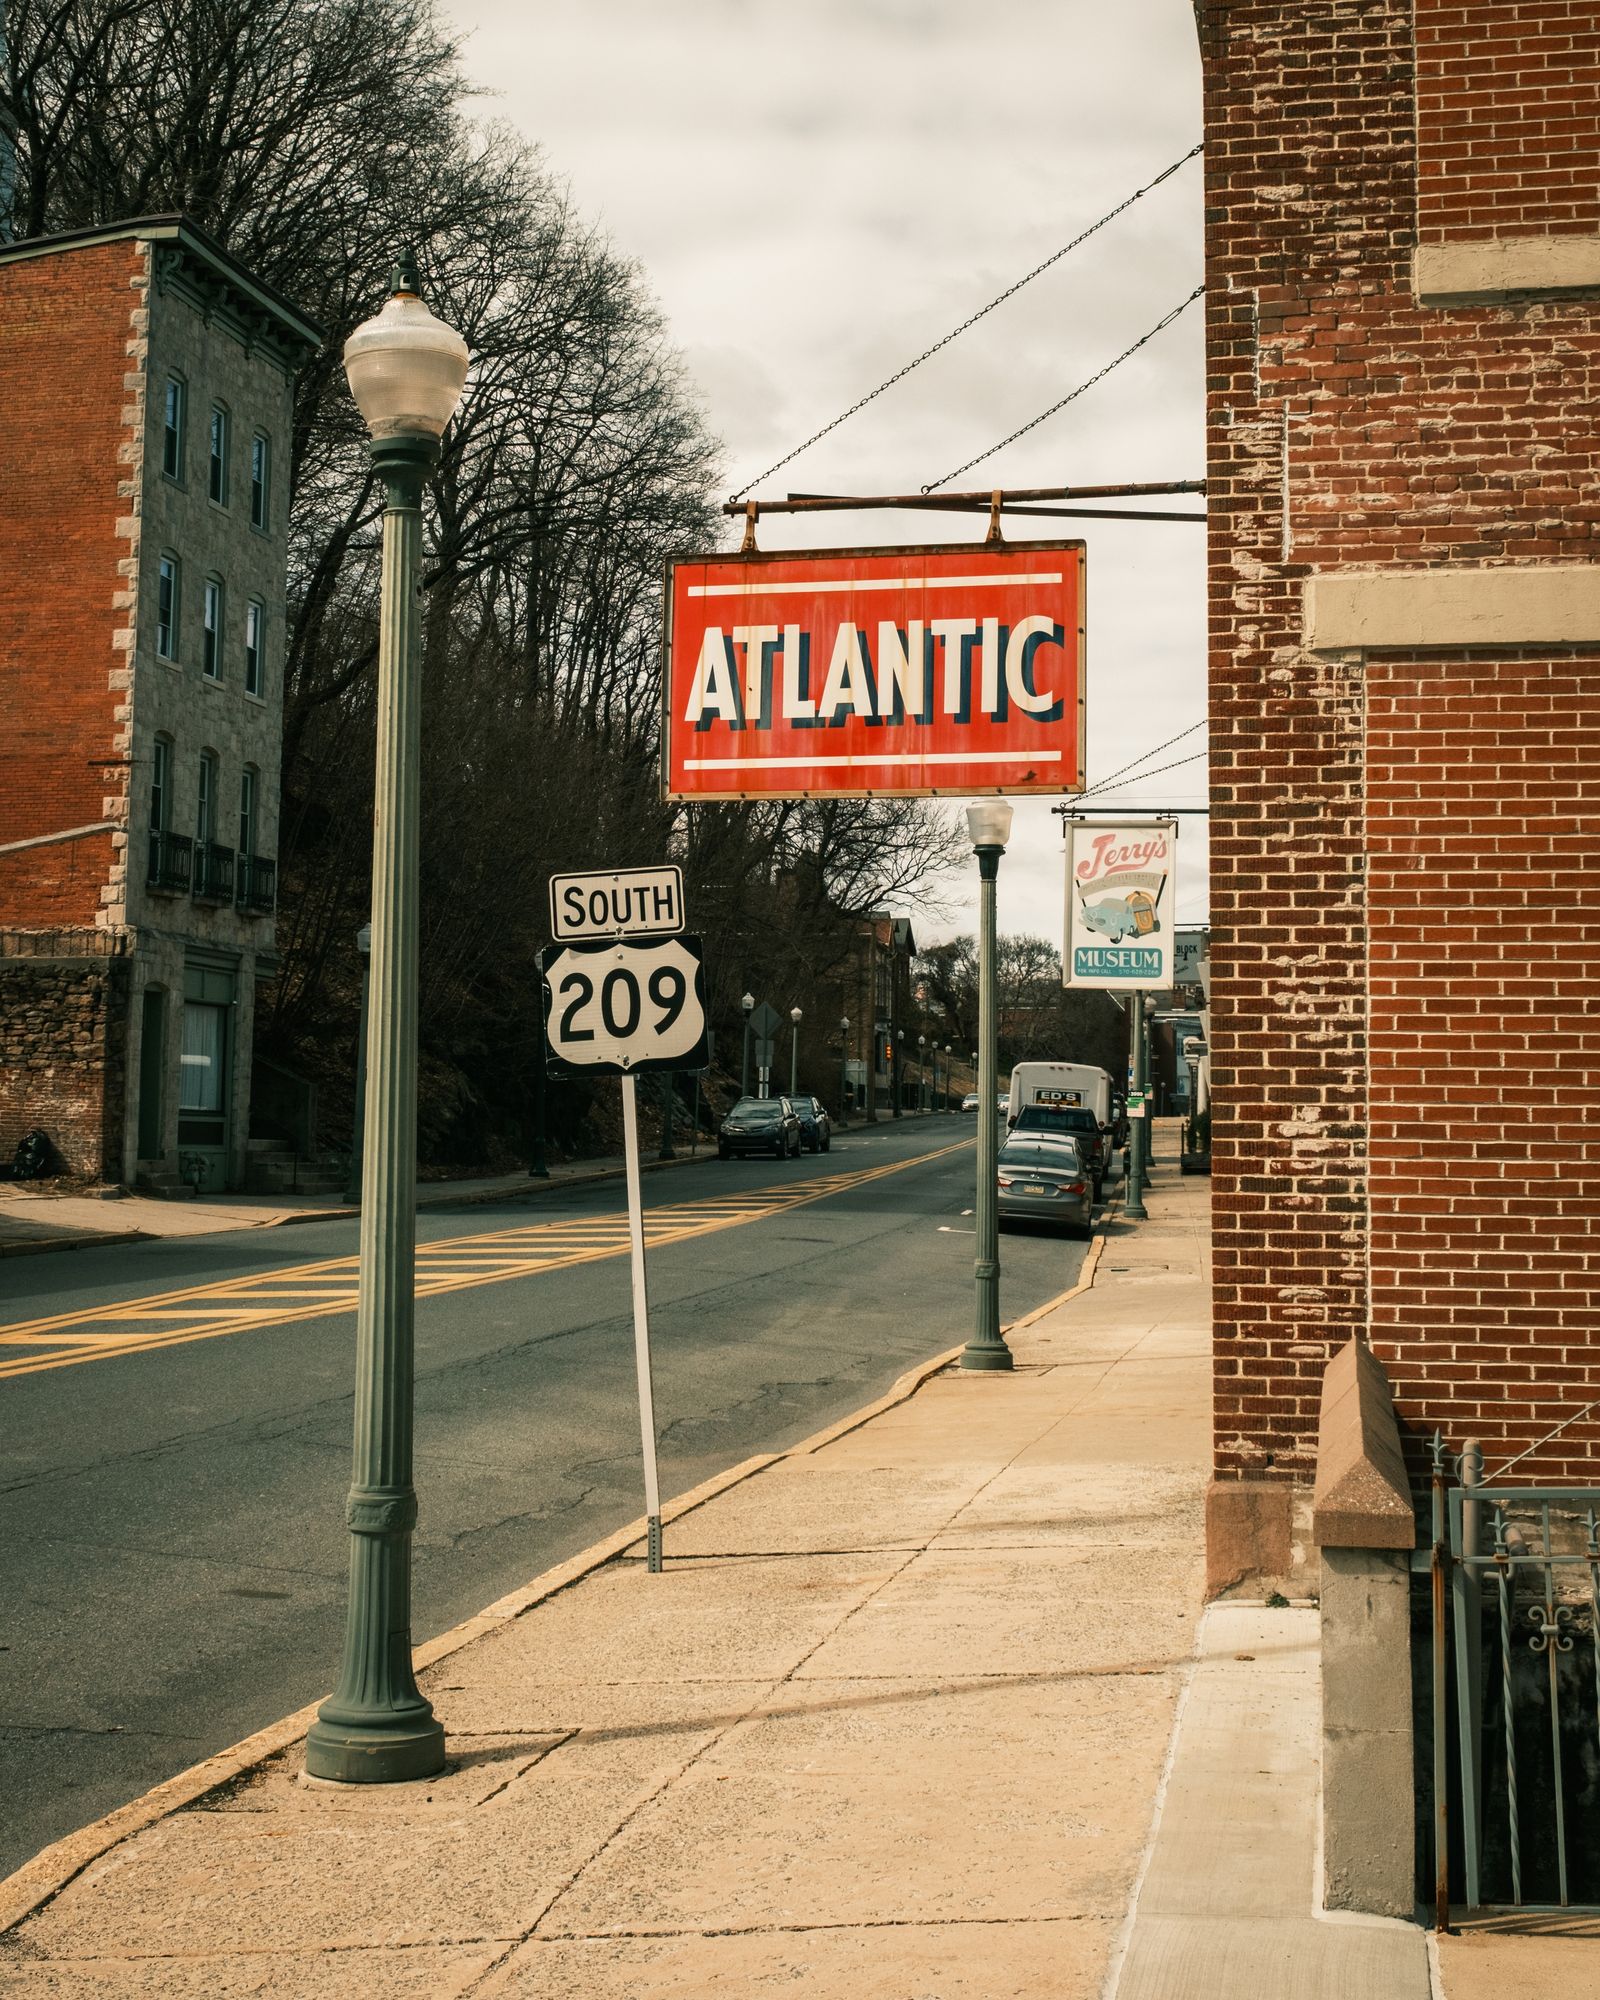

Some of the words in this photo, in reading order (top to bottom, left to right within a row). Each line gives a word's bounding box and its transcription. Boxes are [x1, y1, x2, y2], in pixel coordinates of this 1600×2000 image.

[684, 614, 1065, 732] ATLANTIC
[1077, 832, 1168, 879] Jerry's
[563, 884, 674, 927] SOUTH
[1077, 950, 1159, 968] MUSEUM
[1176, 943, 1198, 954] BLOCK
[559, 965, 686, 1043] 209
[1040, 1091, 1077, 1101] ED'S
